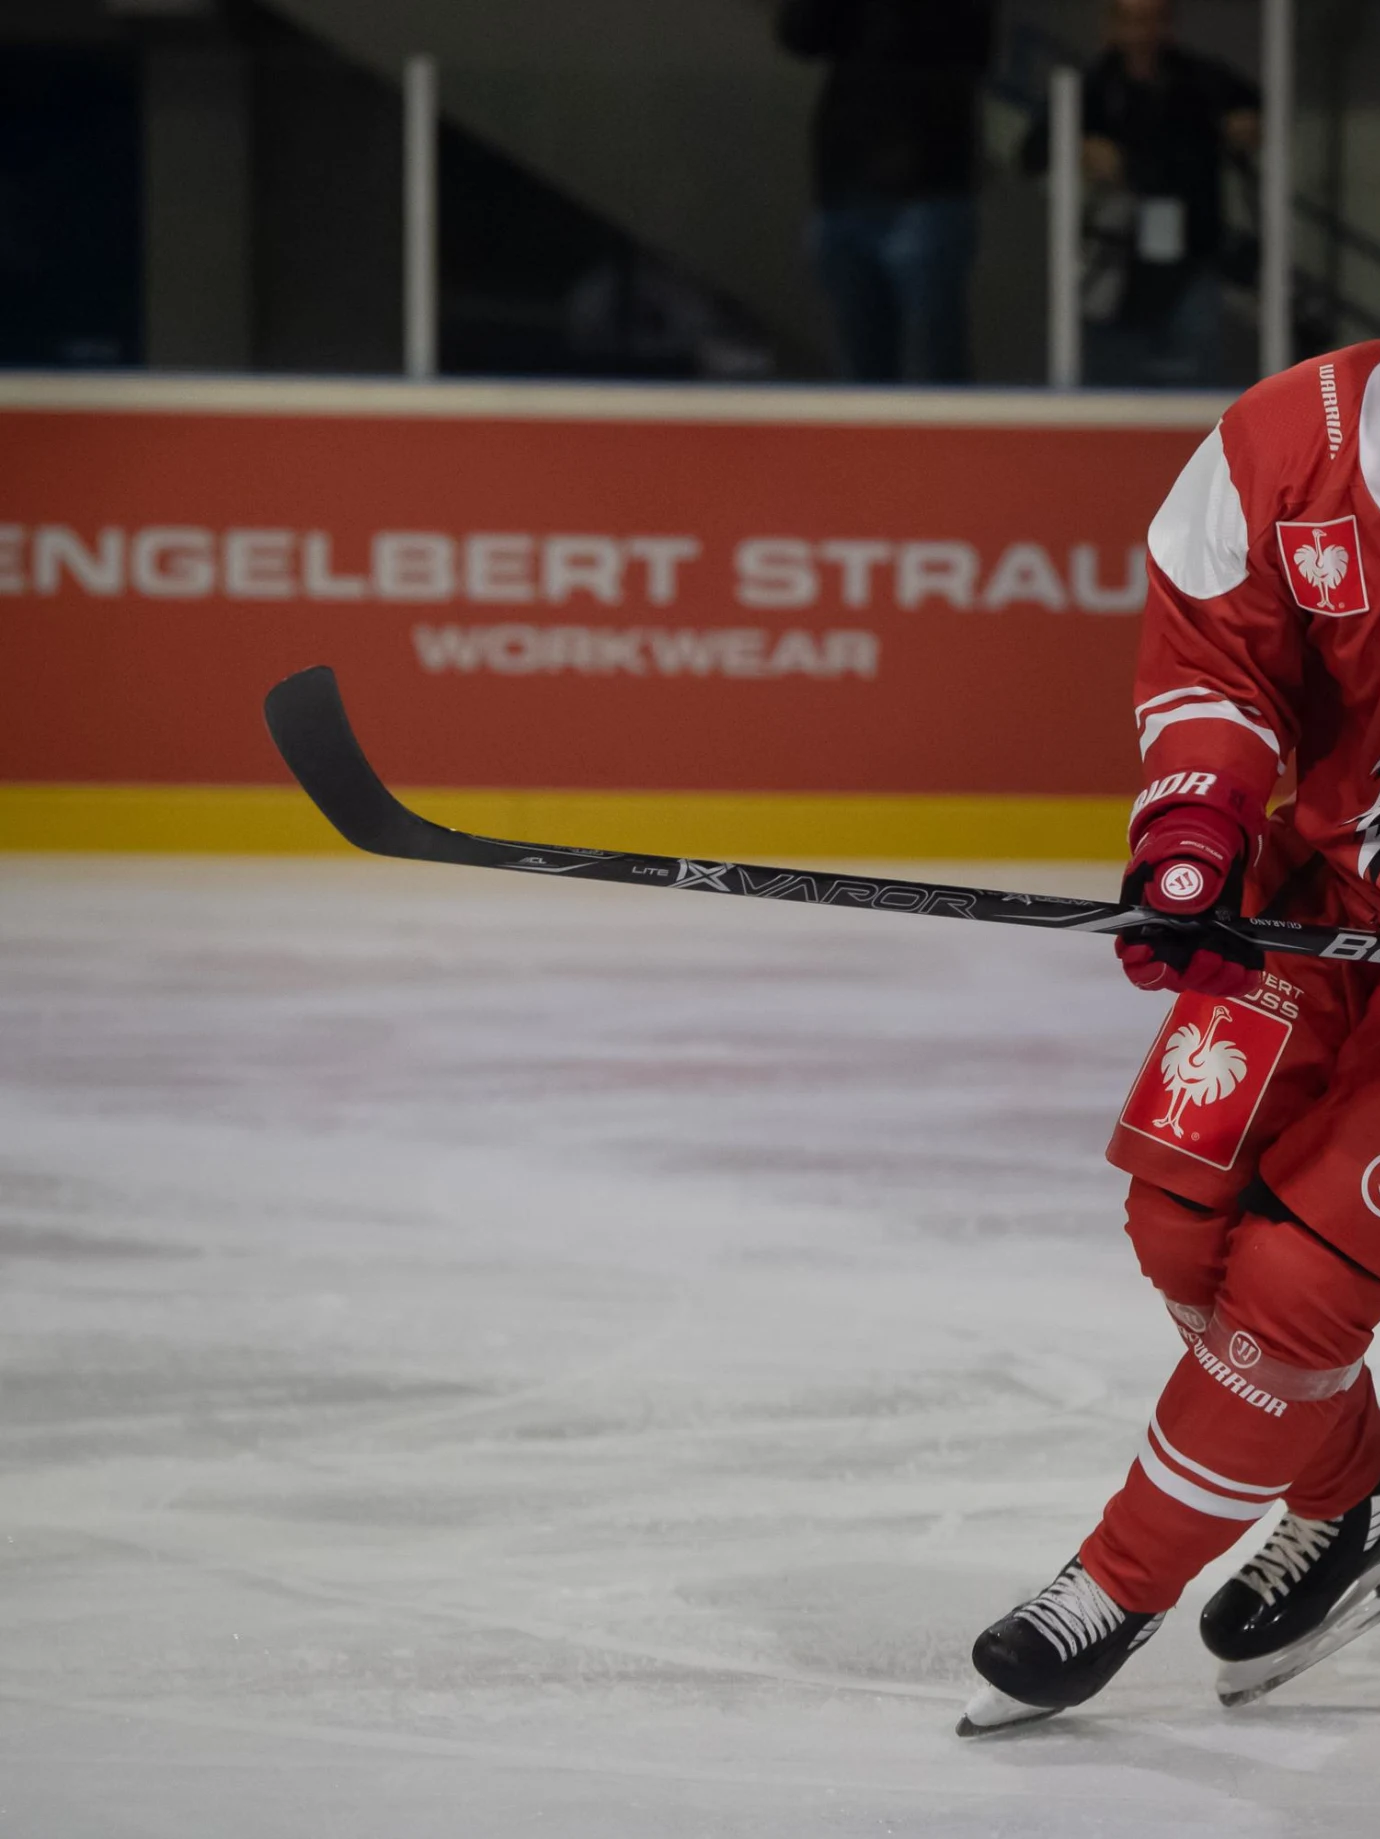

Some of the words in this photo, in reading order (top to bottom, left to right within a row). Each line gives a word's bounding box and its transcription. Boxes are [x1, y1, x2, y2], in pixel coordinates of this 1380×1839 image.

[733, 535, 1148, 612] STRAU
[412, 622, 880, 681] WORKWEAR
[631, 866, 669, 877] LITE
[737, 867, 977, 921] VAPOR
[1262, 970, 1305, 999] ERT
[1193, 1338, 1288, 1418] WARRIOR
